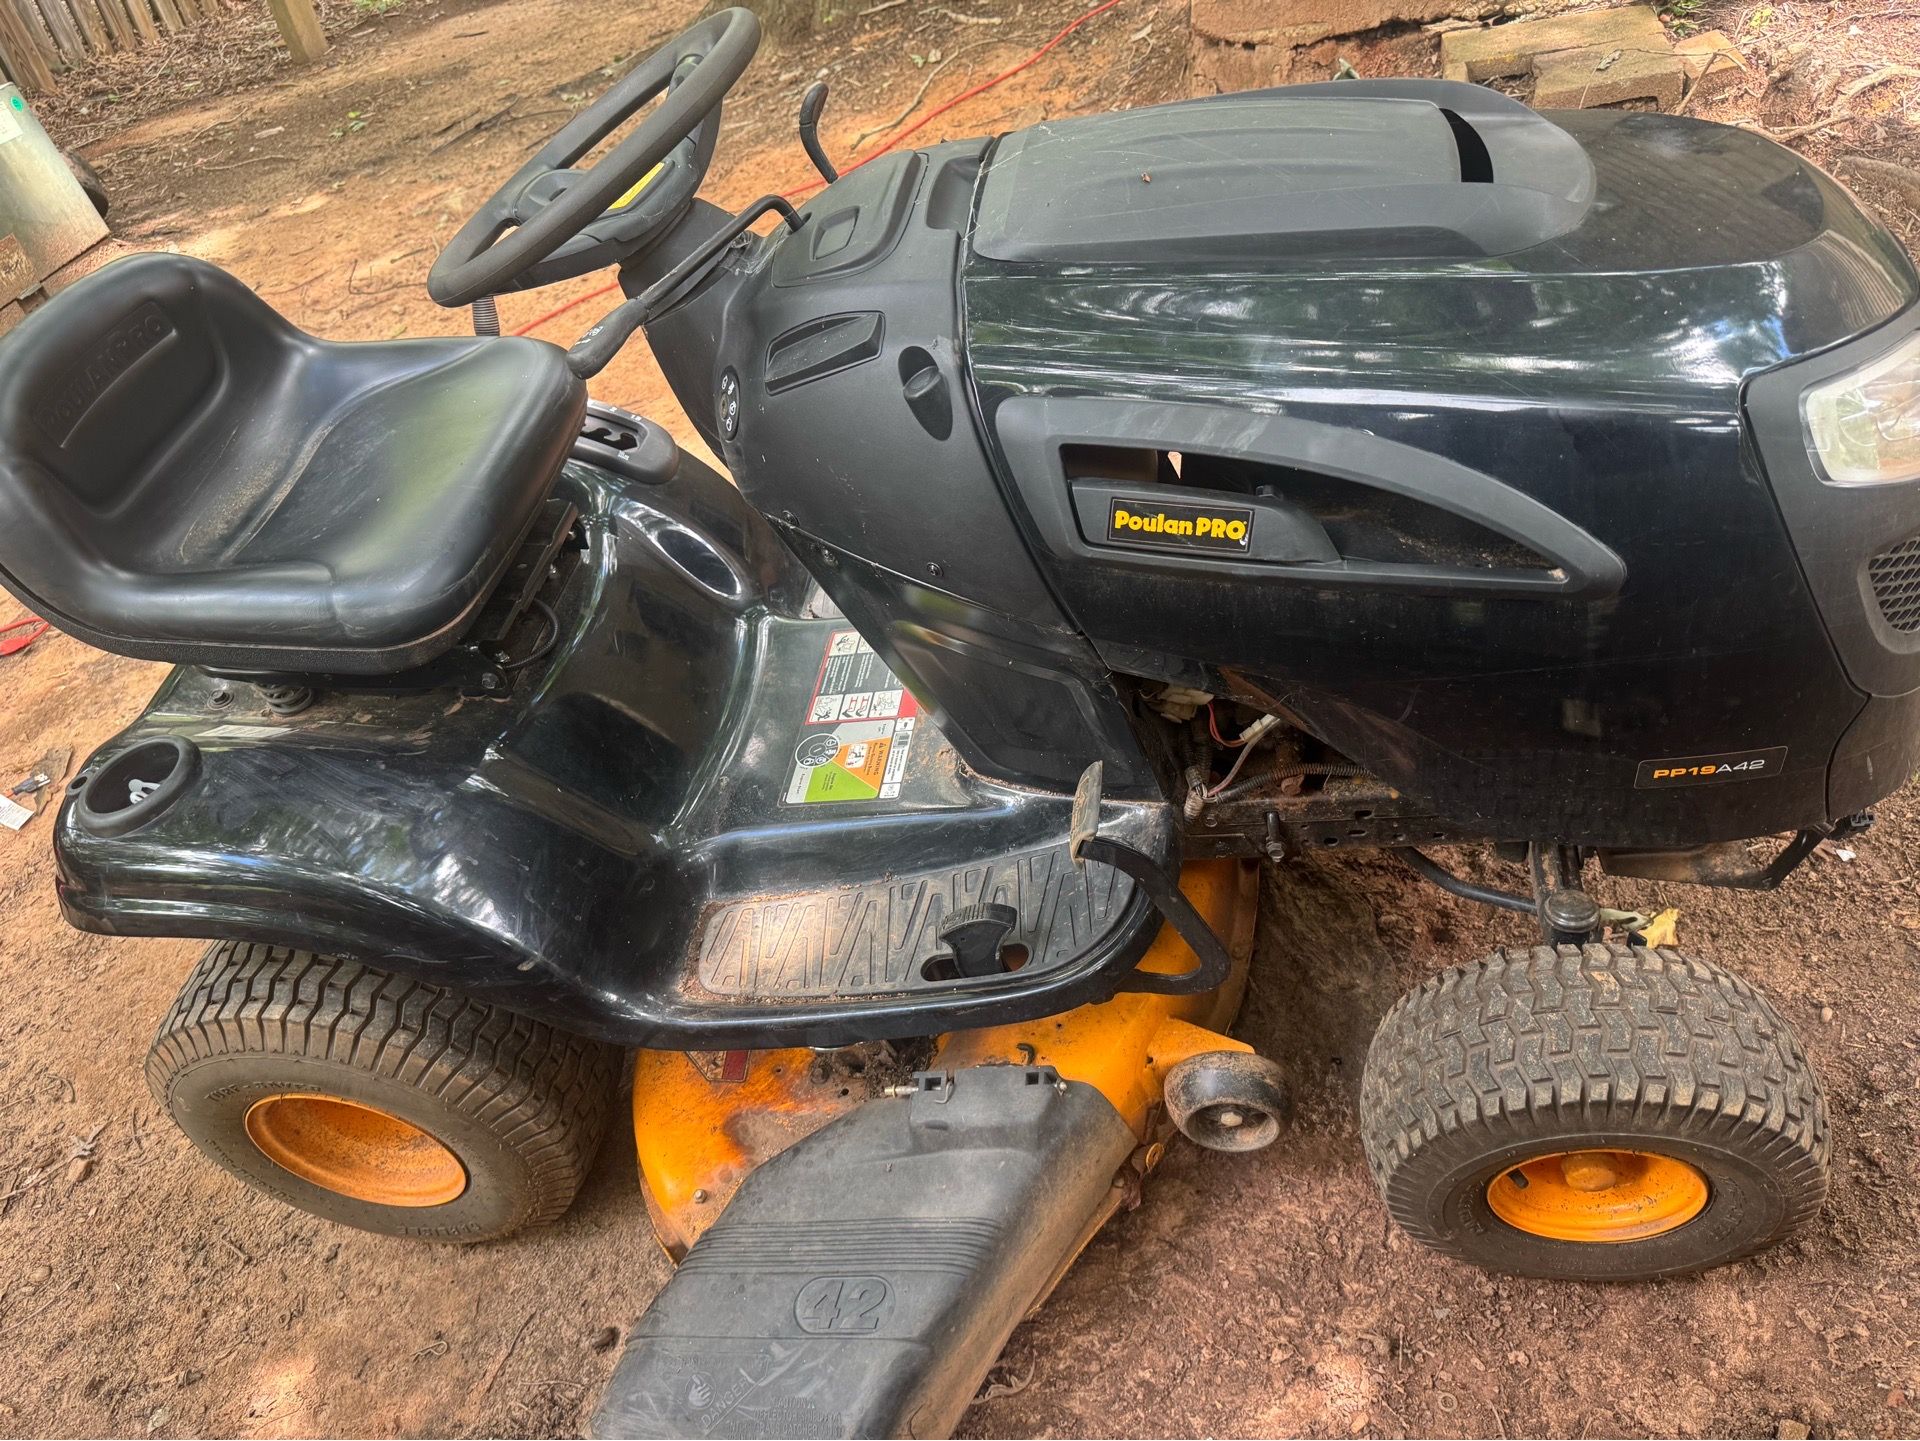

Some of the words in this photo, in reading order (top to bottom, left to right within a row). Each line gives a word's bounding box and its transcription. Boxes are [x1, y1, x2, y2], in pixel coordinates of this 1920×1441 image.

[1114, 510, 1194, 536] Poulan
[1195, 516, 1246, 541] PRO
[1653, 759, 1765, 779] PP19A42
[802, 1279, 887, 1330] 42
[701, 1376, 753, 1429] DANGER
